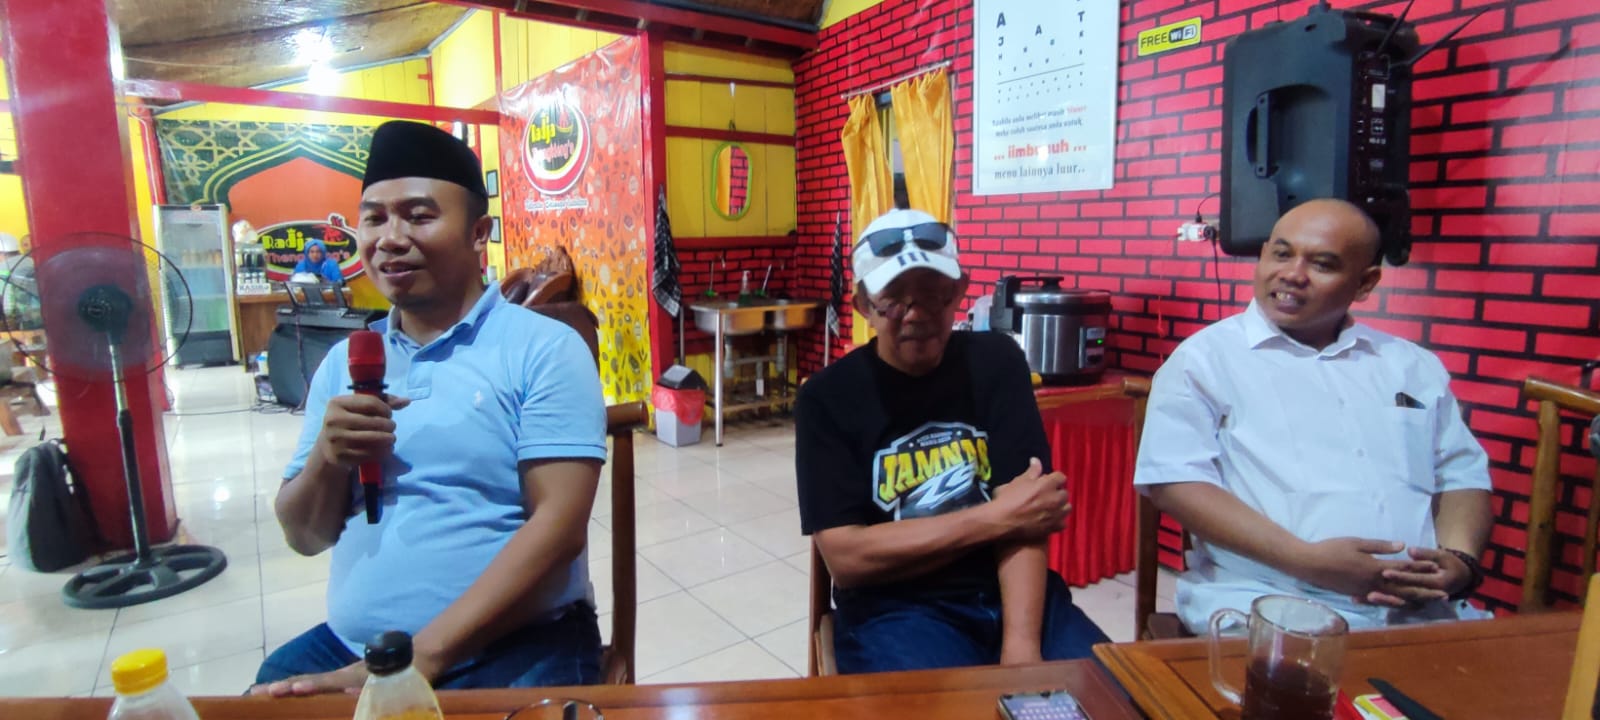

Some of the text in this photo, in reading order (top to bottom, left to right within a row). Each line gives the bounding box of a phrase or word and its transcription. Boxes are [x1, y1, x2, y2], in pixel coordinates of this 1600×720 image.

[996, 11, 1006, 28] A
[1035, 24, 1042, 36] A
[1077, 10, 1086, 22] T
[1141, 32, 1168, 48] FREE
[994, 169, 1018, 179] menu
[1019, 165, 1054, 179] lainnya
[262, 228, 312, 251] Radj
